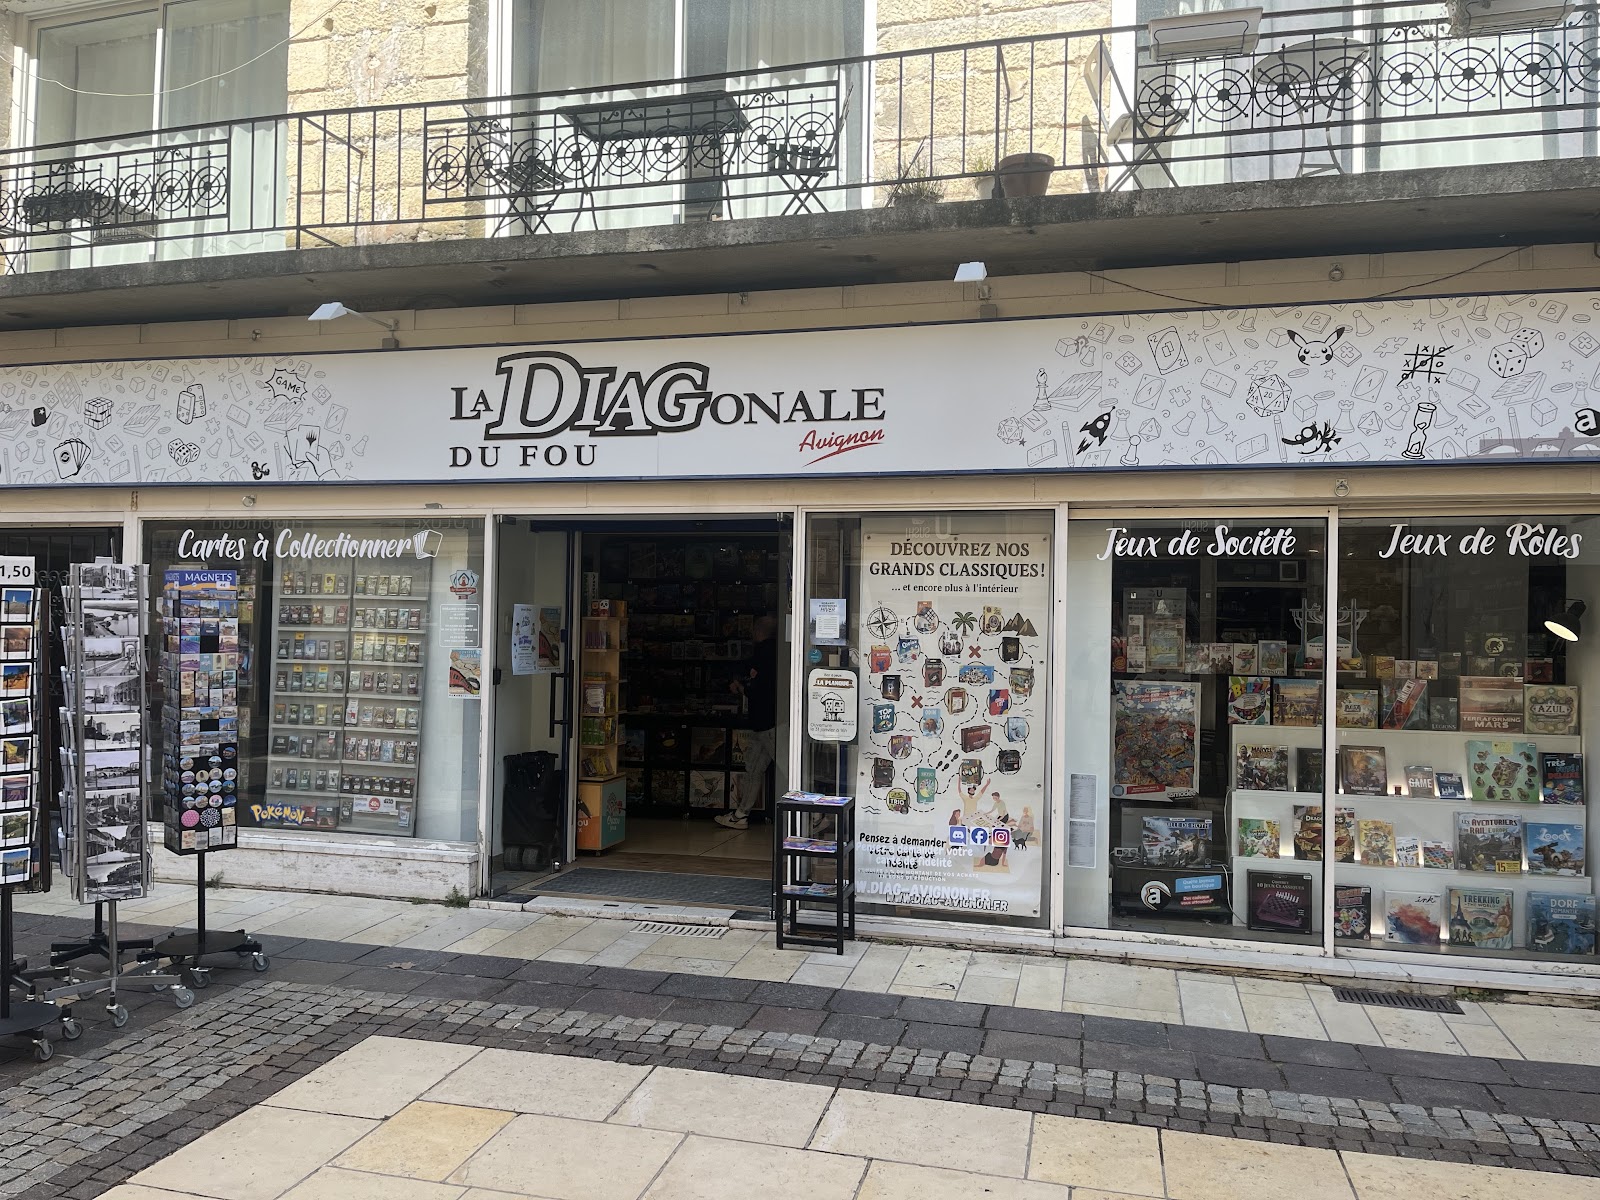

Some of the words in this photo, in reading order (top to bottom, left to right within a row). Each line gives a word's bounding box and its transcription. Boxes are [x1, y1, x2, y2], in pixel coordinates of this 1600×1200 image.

[275, 375, 301, 394] GAME
[449, 386, 494, 421] LA
[799, 428, 885, 454] Avignon
[449, 445, 500, 468] DU
[519, 444, 597, 468] FOU
[178, 528, 247, 561] Cartes
[252, 533, 270, 561] à
[275, 528, 411, 560] Collectionner
[1096, 527, 1161, 560] Jeux
[1167, 529, 1200, 556] de
[1206, 525, 1297, 557] Société
[1378, 523, 1451, 559] Jeux
[1459, 527, 1496, 555] de
[1506, 523, 1583, 559] Rôles
[890, 538, 991, 557] DÉCOUVREZ
[996, 542, 1030, 557] NOS
[869, 562, 935, 577] GRANDS
[185, 572, 233, 582] MAGNETS
[944, 584, 963, 593] plus
[972, 583, 1019, 593] l'intérieur
[878, 708, 893, 716] TOP
[1537, 705, 1565, 713] AZUL
[1463, 716, 1521, 724] TERRAFORMING
[1474, 721, 1509, 729] MARS
[1408, 777, 1432, 788] GAME
[1472, 818, 1518, 826] AVENTURIERS
[859, 832, 890, 845] Pensez
[892, 834, 898, 845] à
[901, 835, 947, 848] demander
[947, 847, 973, 857] votre
[1497, 862, 1506, 872] 15
[1414, 896, 1437, 904] ink
[1463, 894, 1501, 905] TREKKING
[1550, 898, 1580, 909] DORF
